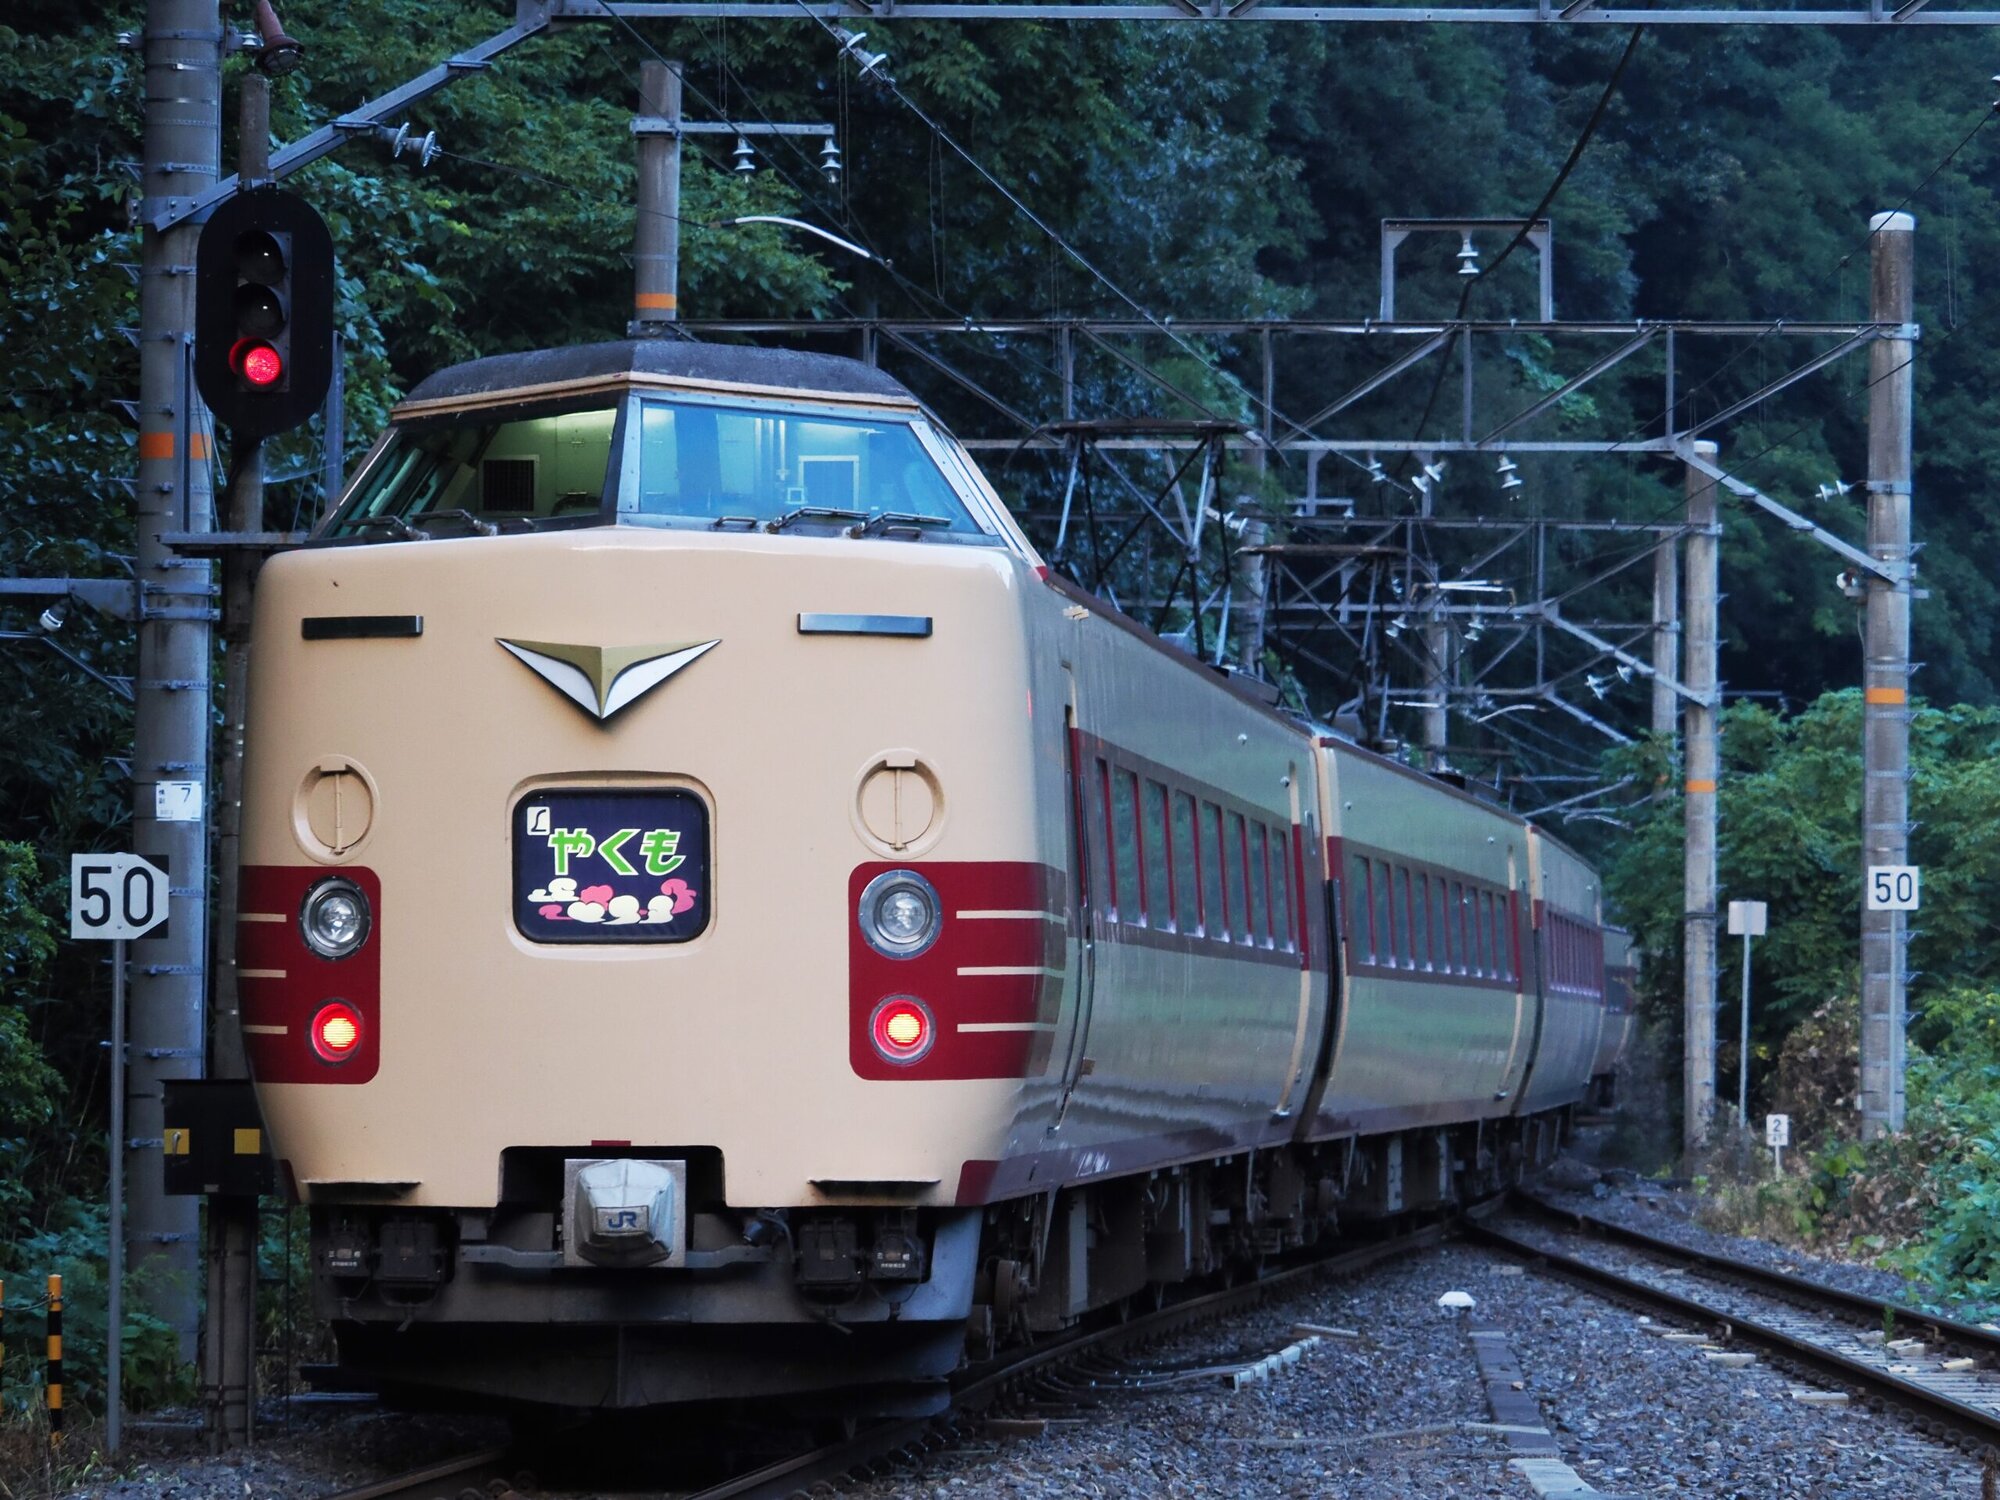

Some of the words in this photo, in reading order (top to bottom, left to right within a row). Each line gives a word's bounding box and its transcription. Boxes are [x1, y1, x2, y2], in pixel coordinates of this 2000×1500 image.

[181, 787, 191, 803] 7
[547, 828, 687, 876] やくも
[80, 866, 154, 927] 50
[1875, 872, 1912, 903] 50
[1773, 1118, 1781, 1132] 2
[608, 1211, 637, 1228] JR
